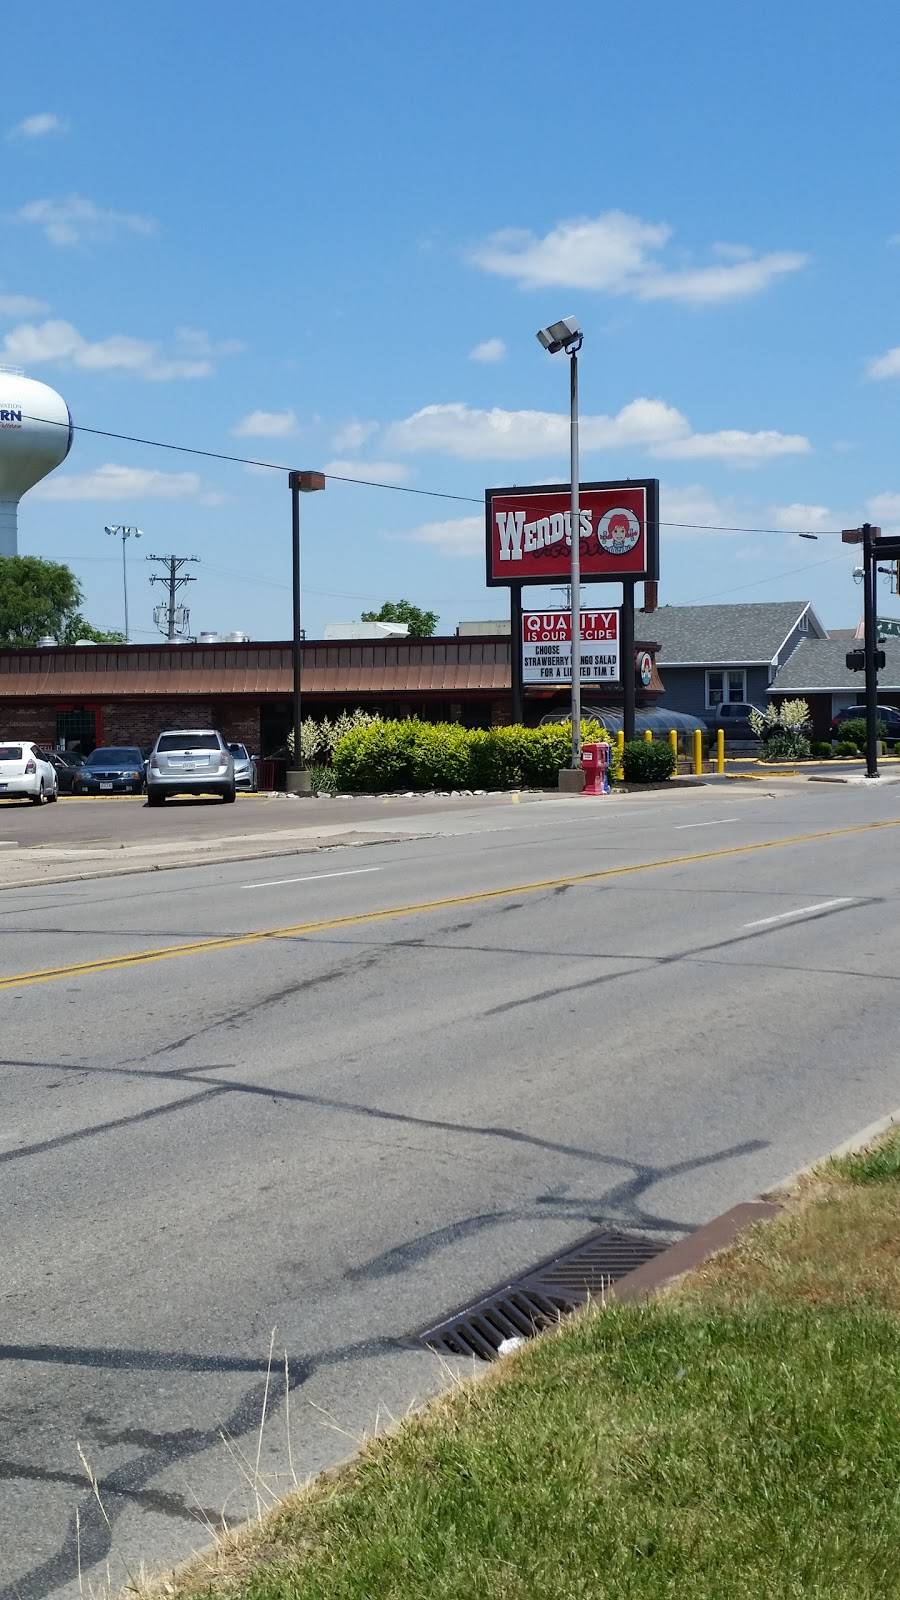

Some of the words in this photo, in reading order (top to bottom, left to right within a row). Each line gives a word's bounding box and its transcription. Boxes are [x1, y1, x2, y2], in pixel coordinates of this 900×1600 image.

[496, 509, 593, 560] WENDYS
[527, 613, 613, 631] QUAITY
[527, 632, 538, 641] IS
[541, 631, 566, 641] OUR
[535, 645, 560, 655] CHOOSE
[524, 656, 569, 666] STRAWBERRY
[595, 655, 617, 665] SALAD
[540, 667, 553, 677] FOR
[556, 667, 561, 677] A
